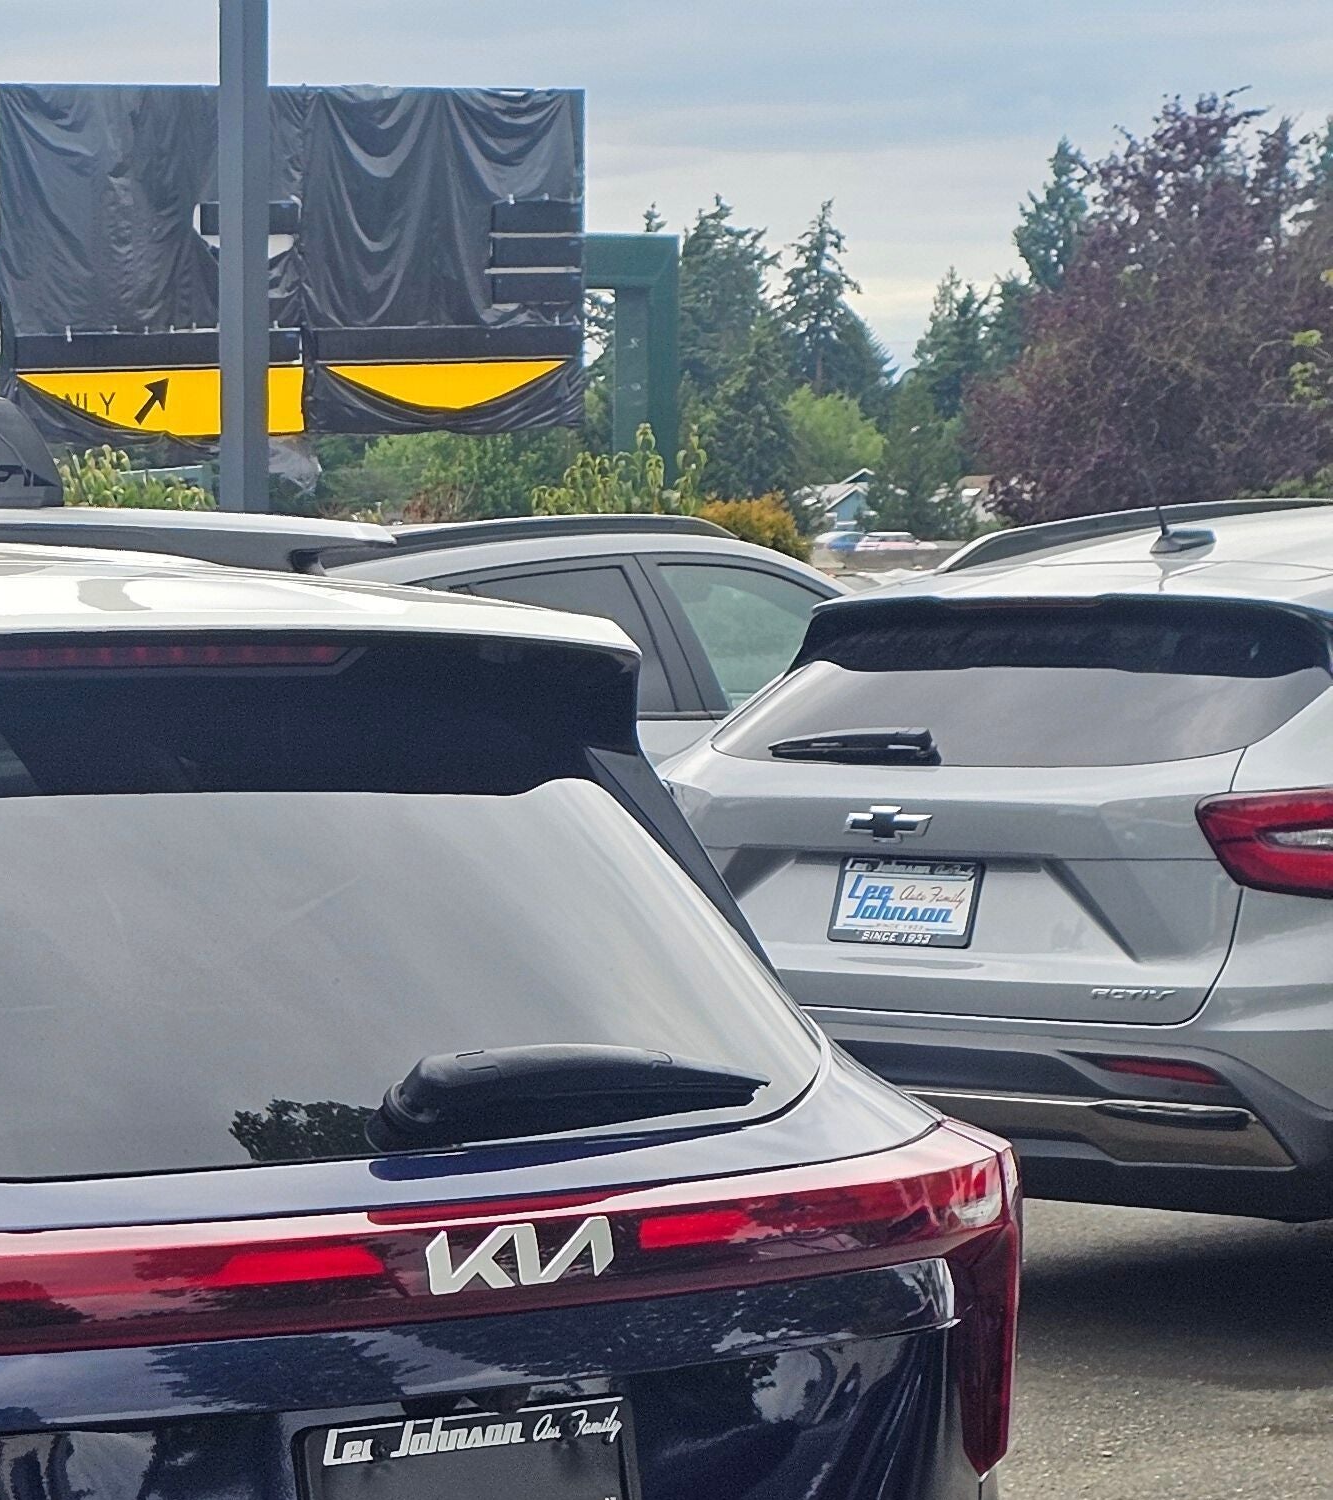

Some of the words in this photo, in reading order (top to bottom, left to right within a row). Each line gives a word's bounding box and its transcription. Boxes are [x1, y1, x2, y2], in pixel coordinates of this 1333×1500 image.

[57, 391, 116, 416] NLY
[846, 888, 953, 923] Johnson
[848, 874, 895, 900] Lee
[899, 885, 927, 901] Auto
[930, 886, 967, 909] Family
[861, 930, 899, 942] SINCE
[901, 932, 932, 944] 1933
[424, 1216, 614, 1295] KIA
[390, 1416, 526, 1459] Johnson
[571, 1405, 623, 1443] Family
